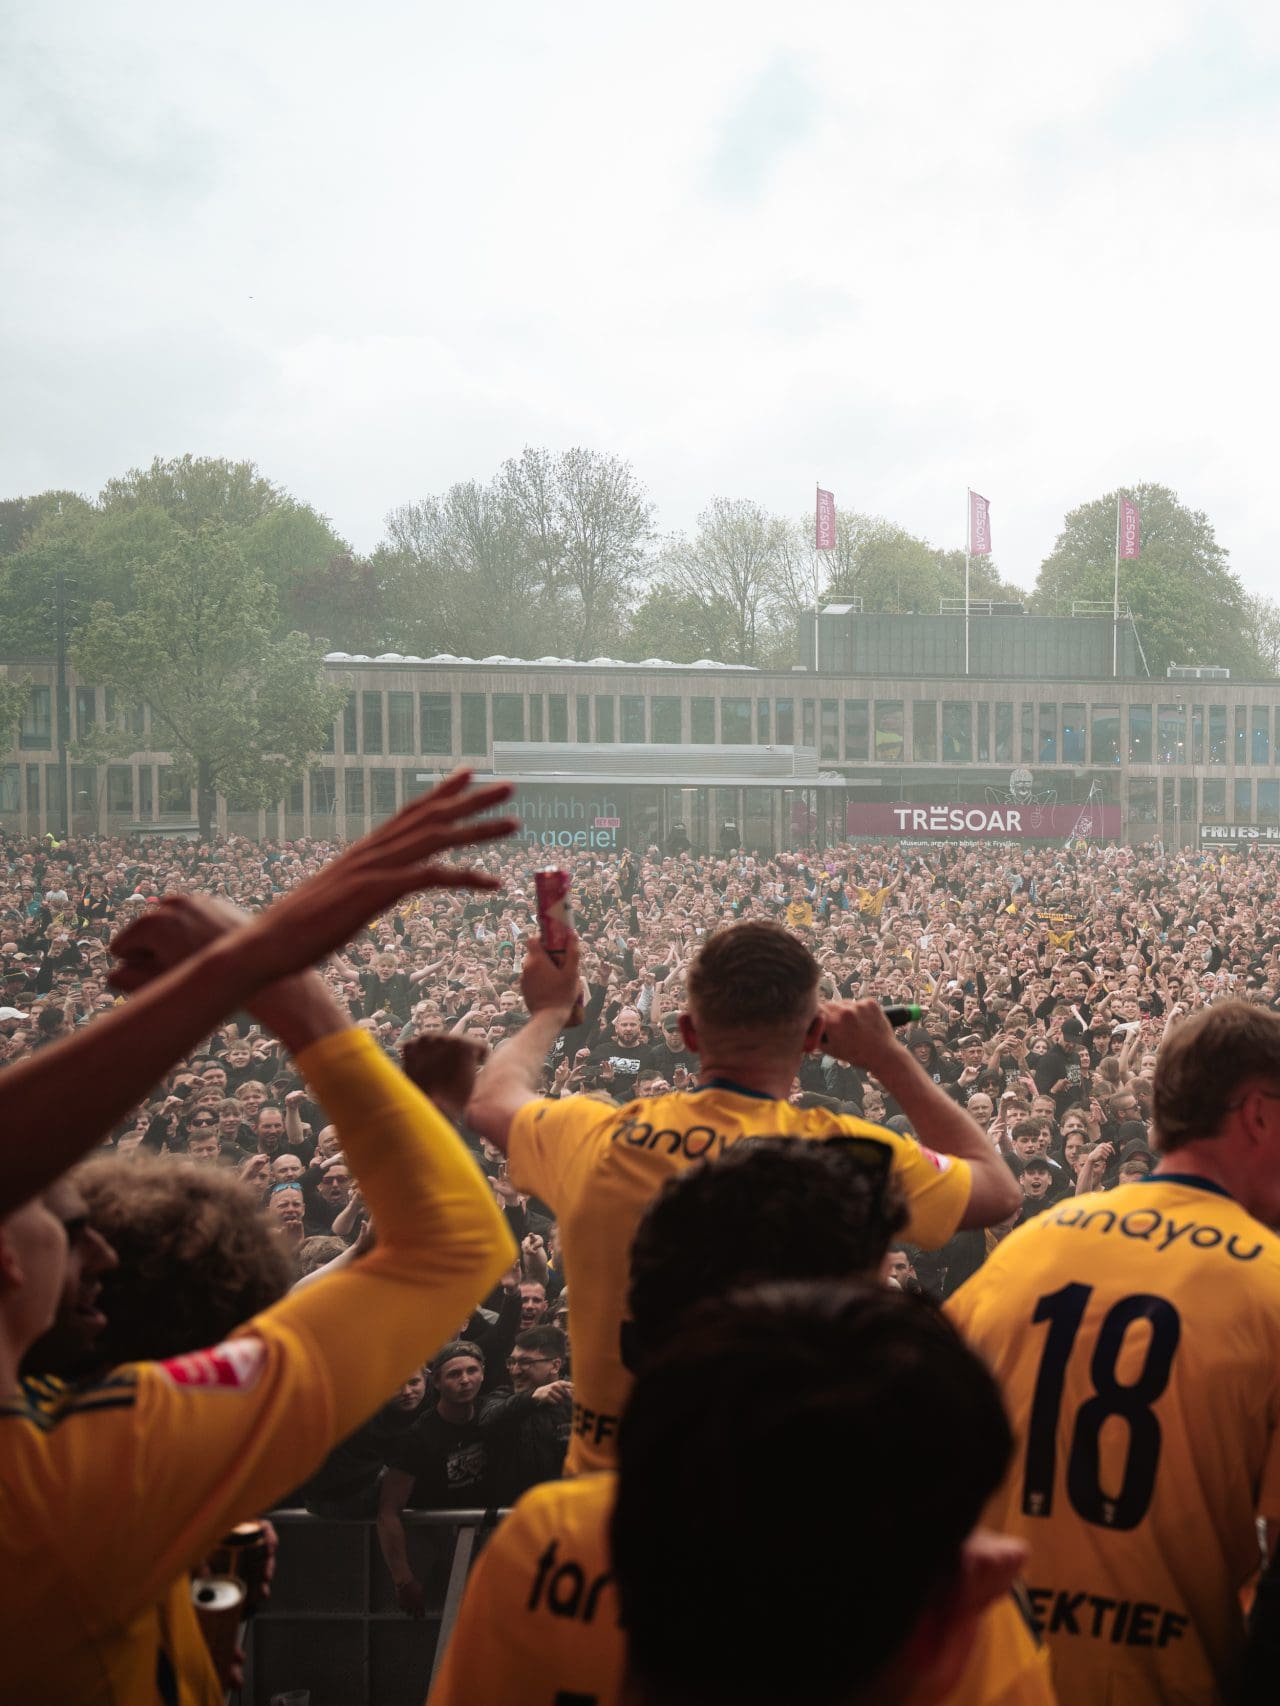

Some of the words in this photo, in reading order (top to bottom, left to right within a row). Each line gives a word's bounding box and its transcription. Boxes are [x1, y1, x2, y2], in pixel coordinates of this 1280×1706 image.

[1042, 1208, 1263, 1262] anQyou
[1020, 1282, 1182, 1532] 18
[1026, 1588, 1190, 1650] EKTIEF
